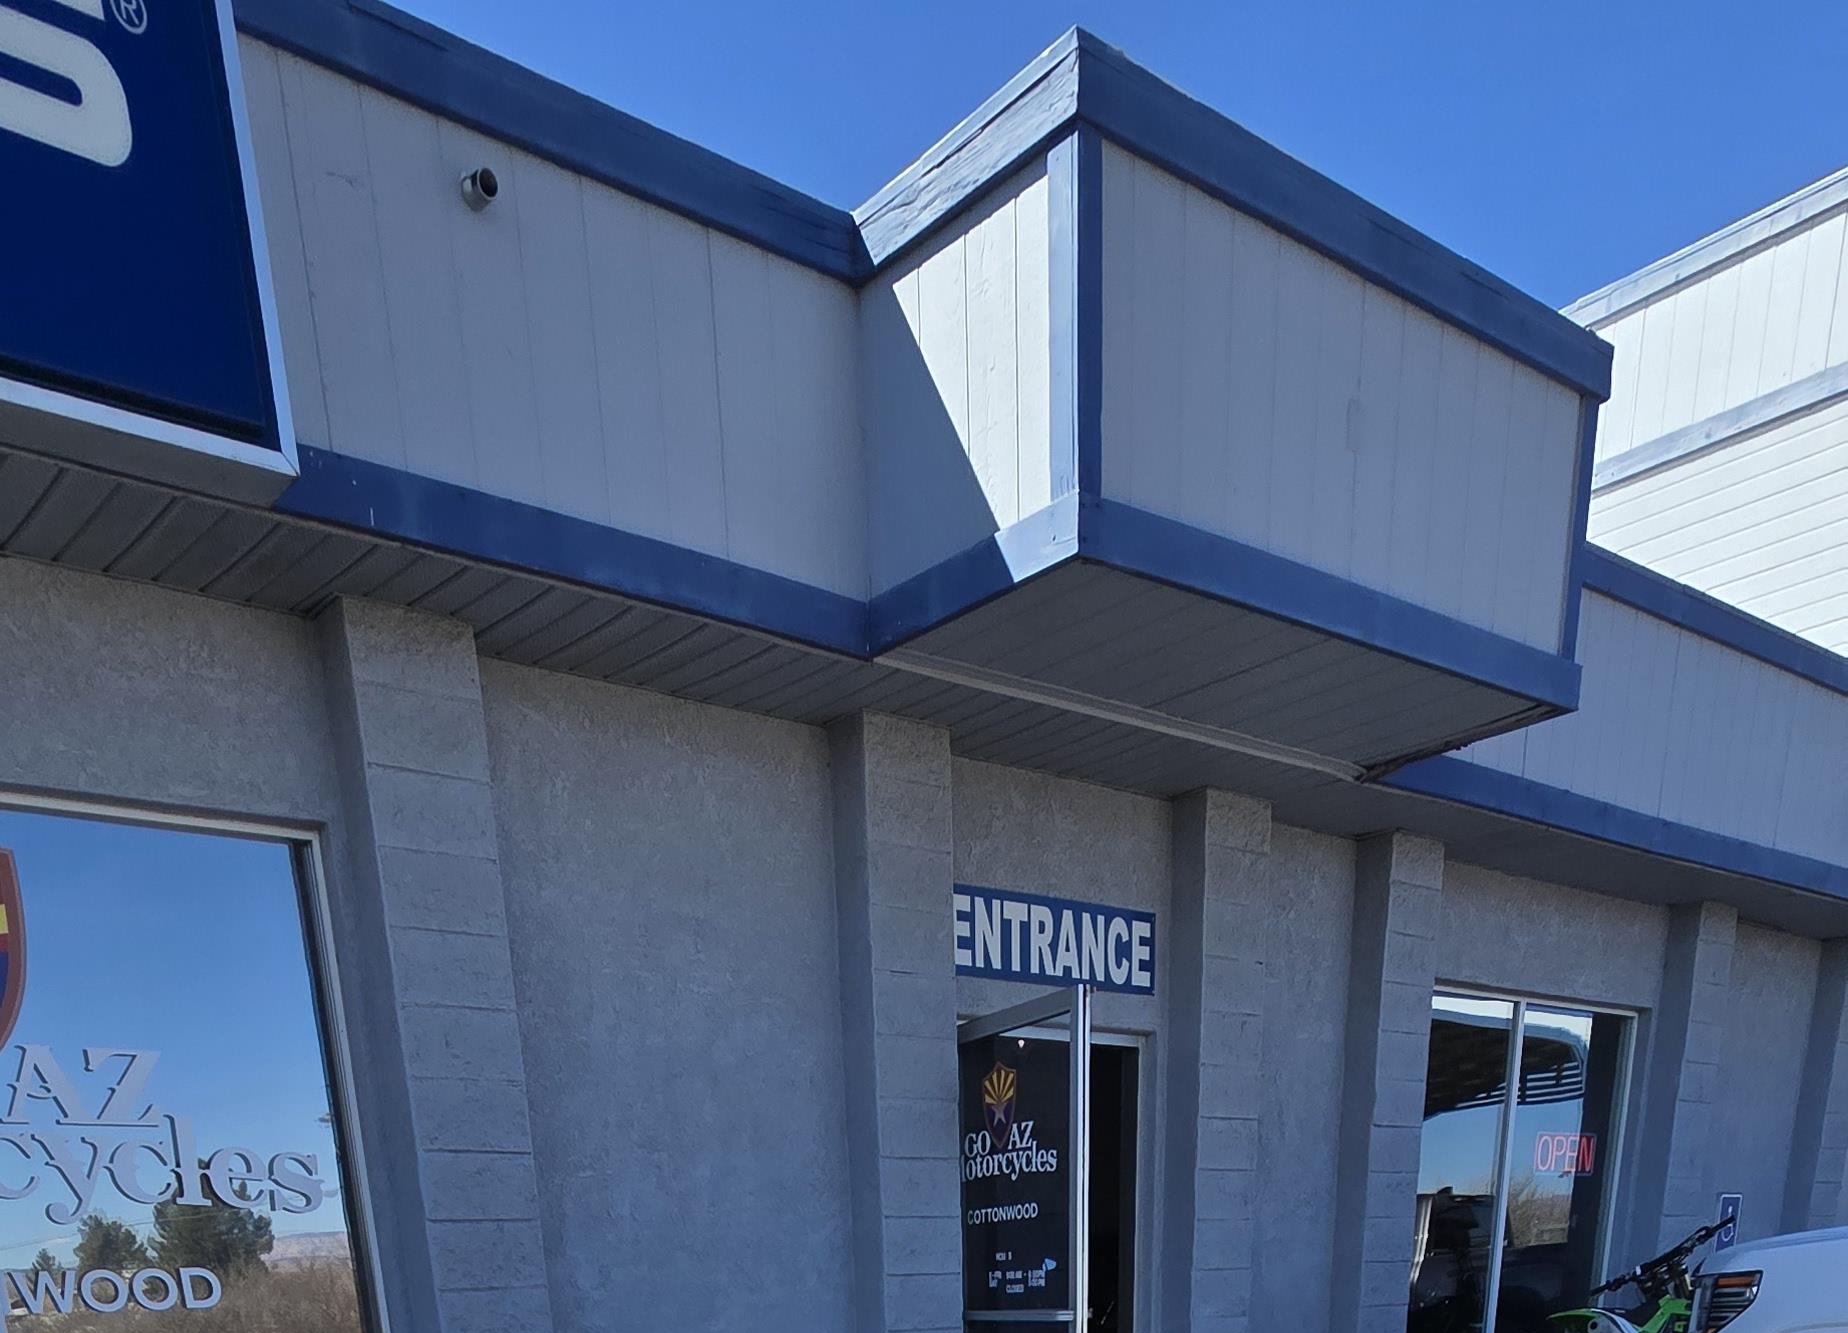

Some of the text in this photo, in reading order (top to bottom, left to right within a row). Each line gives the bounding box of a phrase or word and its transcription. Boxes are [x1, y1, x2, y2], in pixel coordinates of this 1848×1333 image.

[953, 893, 1151, 987] ENTRANCE
[0, 1044, 161, 1128] AZ
[965, 1120, 1034, 1158] GO AZ
[1537, 1135, 1594, 1172] OPEN
[967, 1202, 1039, 1225] COTTONWOOD
